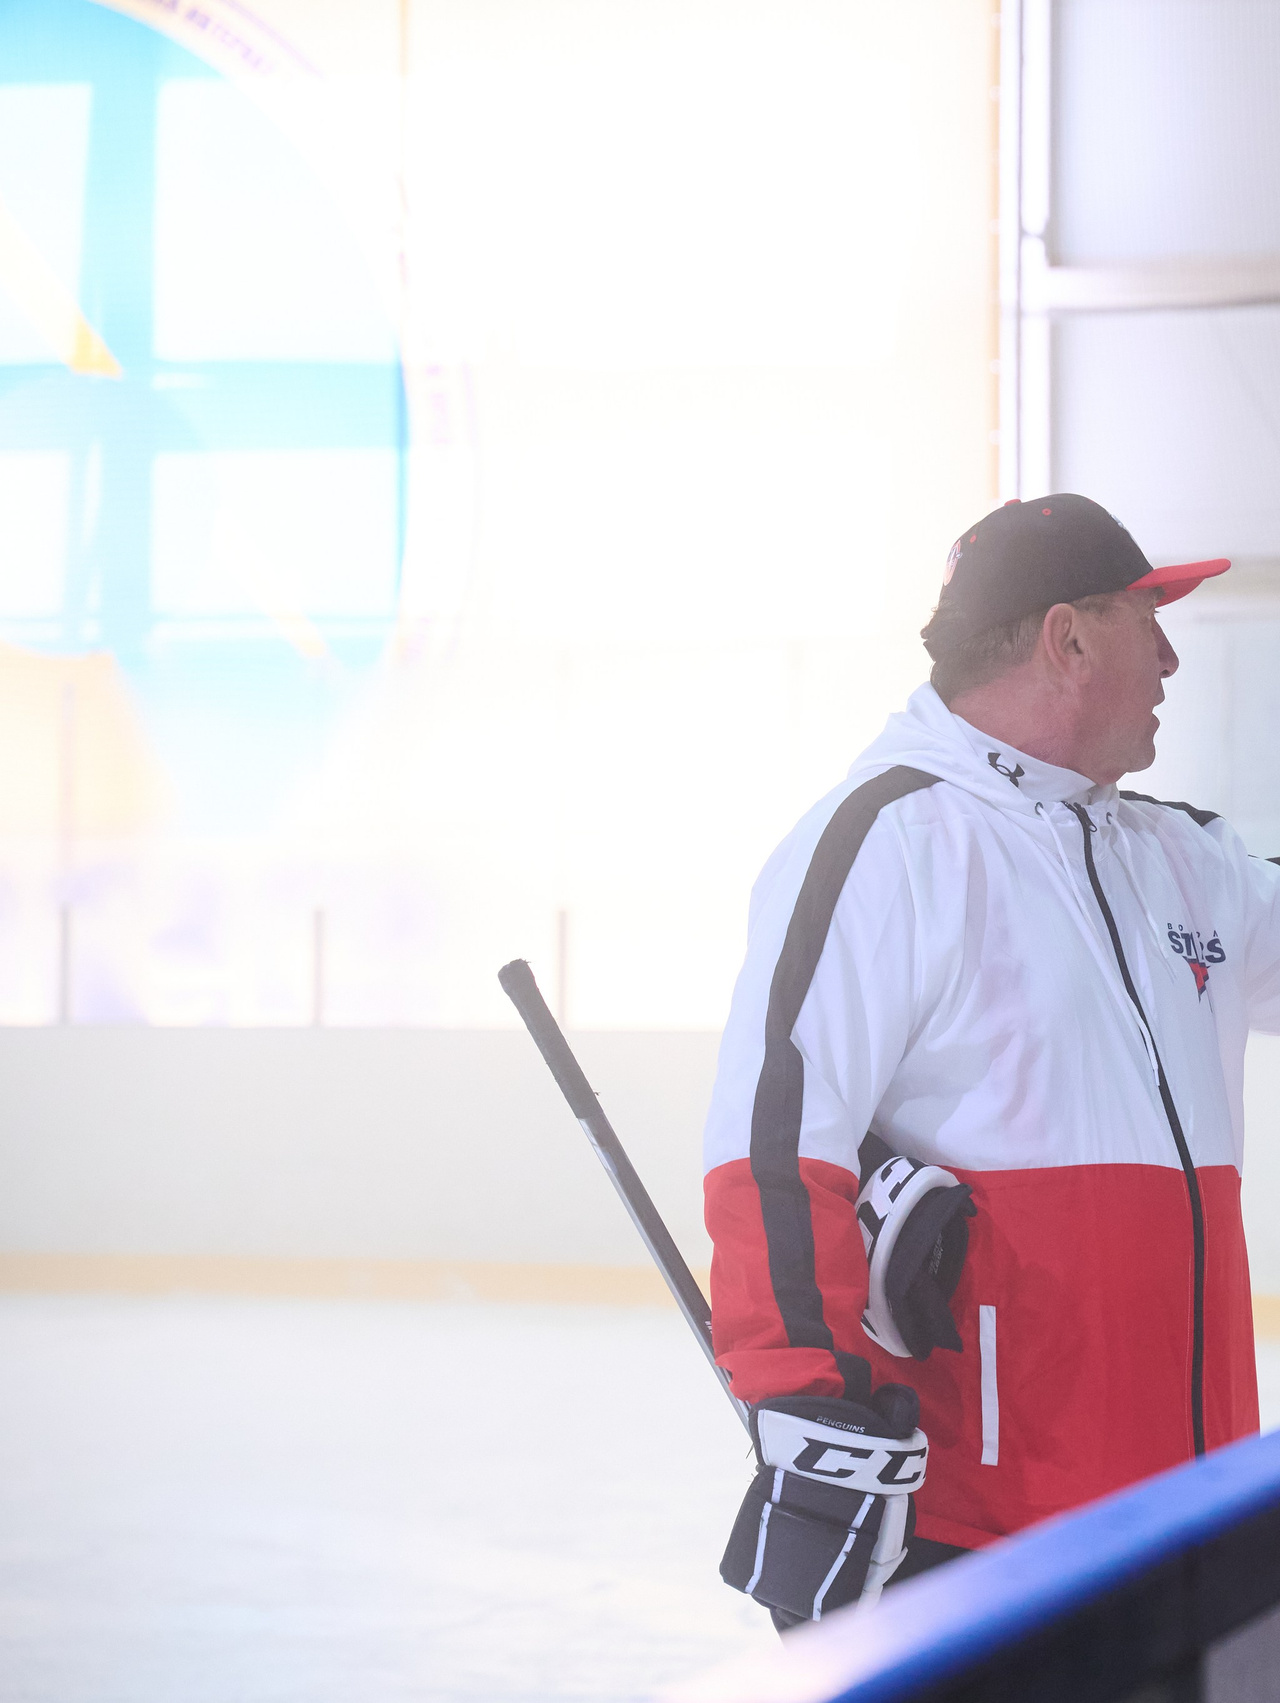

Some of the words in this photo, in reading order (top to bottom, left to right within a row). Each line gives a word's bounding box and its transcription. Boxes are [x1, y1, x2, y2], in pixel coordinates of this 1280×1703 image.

[1167, 930, 1226, 963] STS
[816, 1415, 866, 1434] PENGUINS
[792, 1436, 927, 1485] CC
